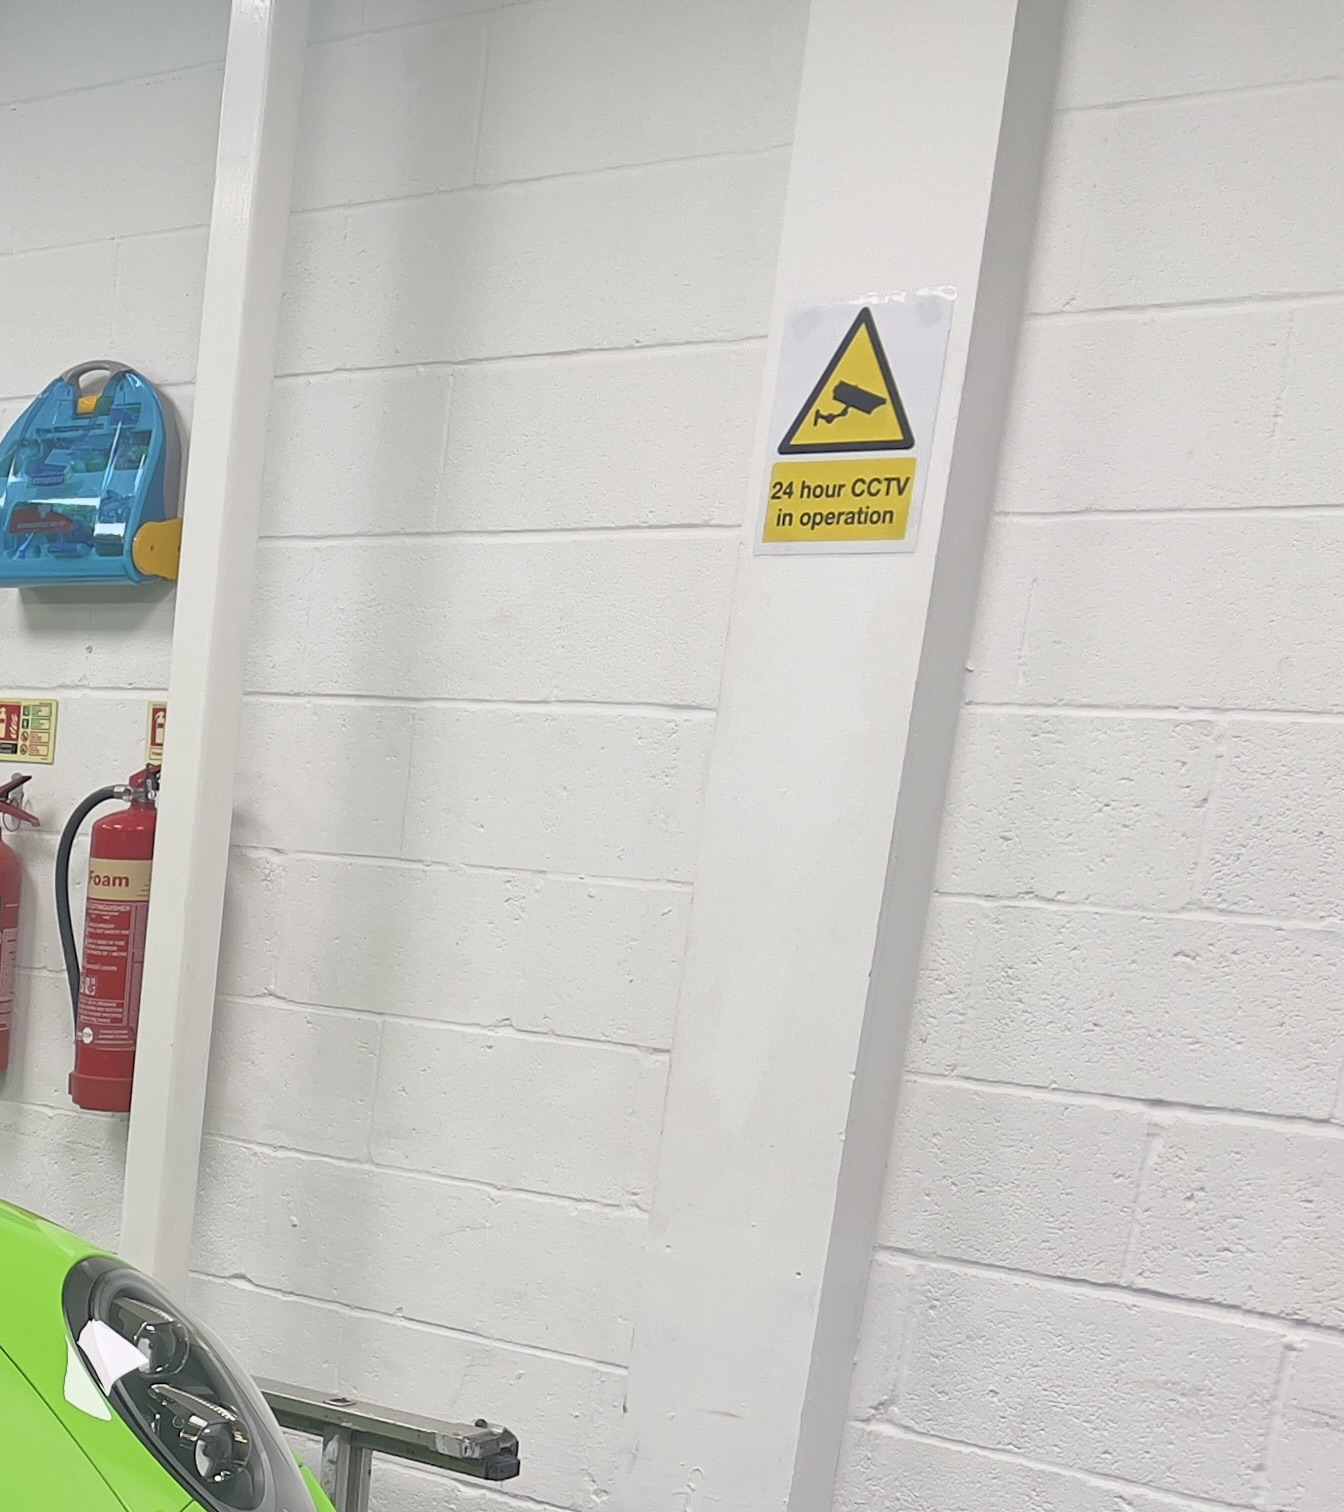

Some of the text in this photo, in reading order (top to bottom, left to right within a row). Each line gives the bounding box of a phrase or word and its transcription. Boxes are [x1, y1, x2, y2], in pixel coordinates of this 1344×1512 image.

[770, 476, 911, 500] 24 hour CCTV
[776, 506, 894, 530] in operation
[89, 871, 129, 888] Foam
